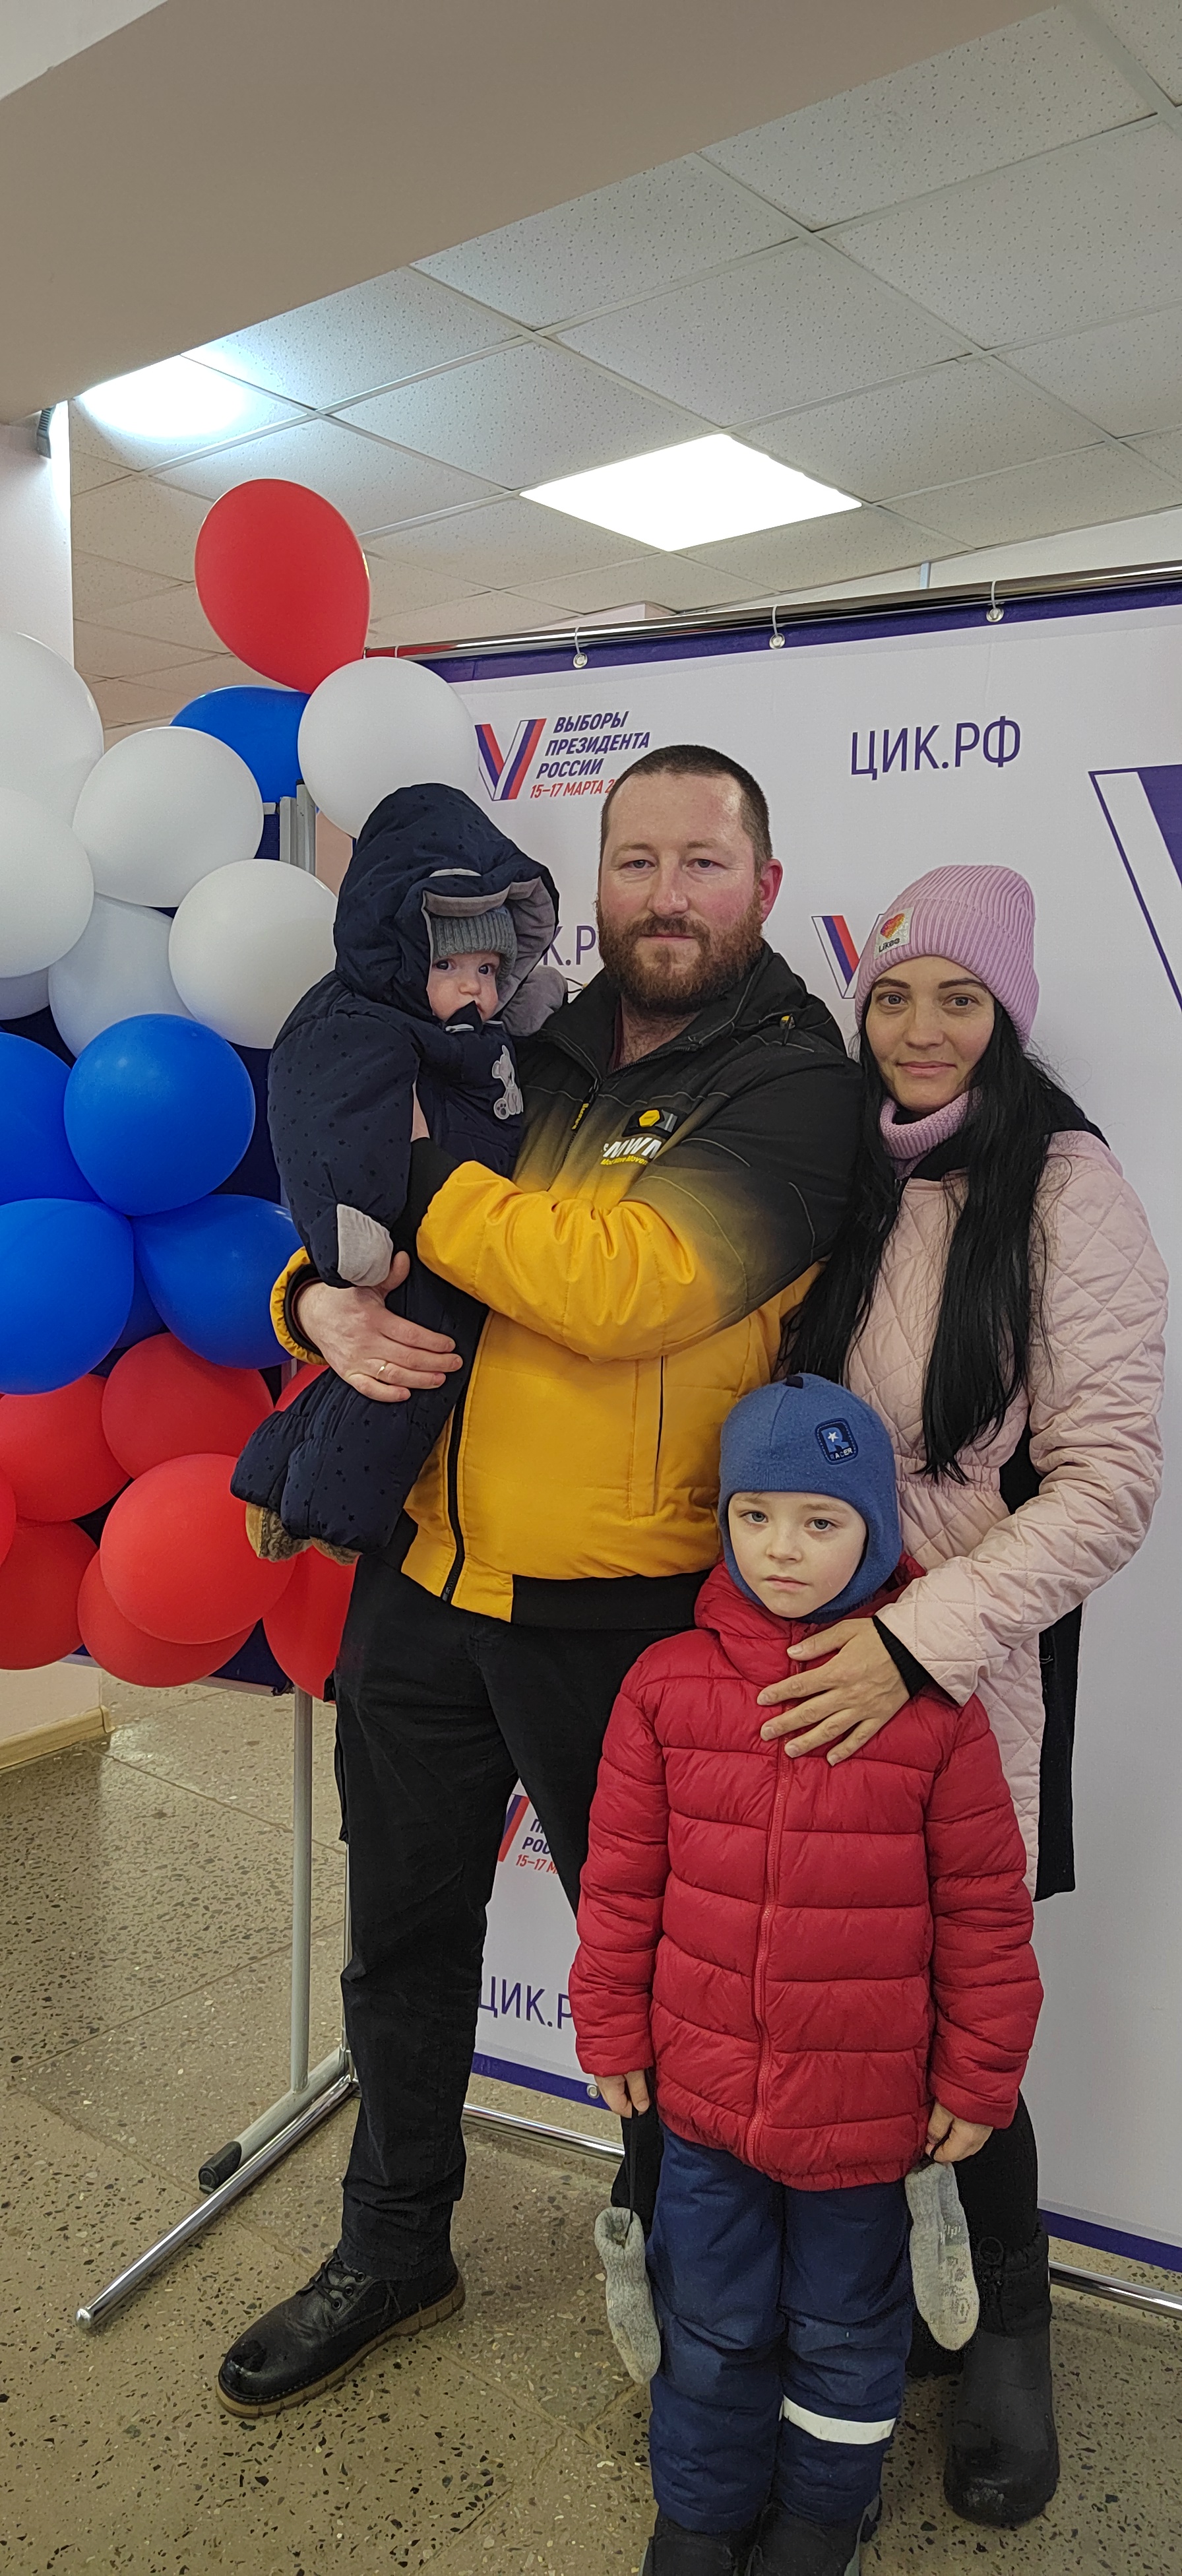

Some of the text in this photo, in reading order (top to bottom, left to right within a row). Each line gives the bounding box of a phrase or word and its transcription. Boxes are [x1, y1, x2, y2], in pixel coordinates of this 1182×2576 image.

[553, 711, 629, 734] ВЫБОРЫ
[545, 731, 650, 756] ПРЕЗИДЕНТА
[851, 715, 1020, 781] ЦИК.РФ
[536, 758, 604, 779] РОССИИ
[563, 780, 603, 796] МАРТА
[830, 1447, 854, 1460] RACER
[478, 1976, 573, 2030] ЦИК.Р
